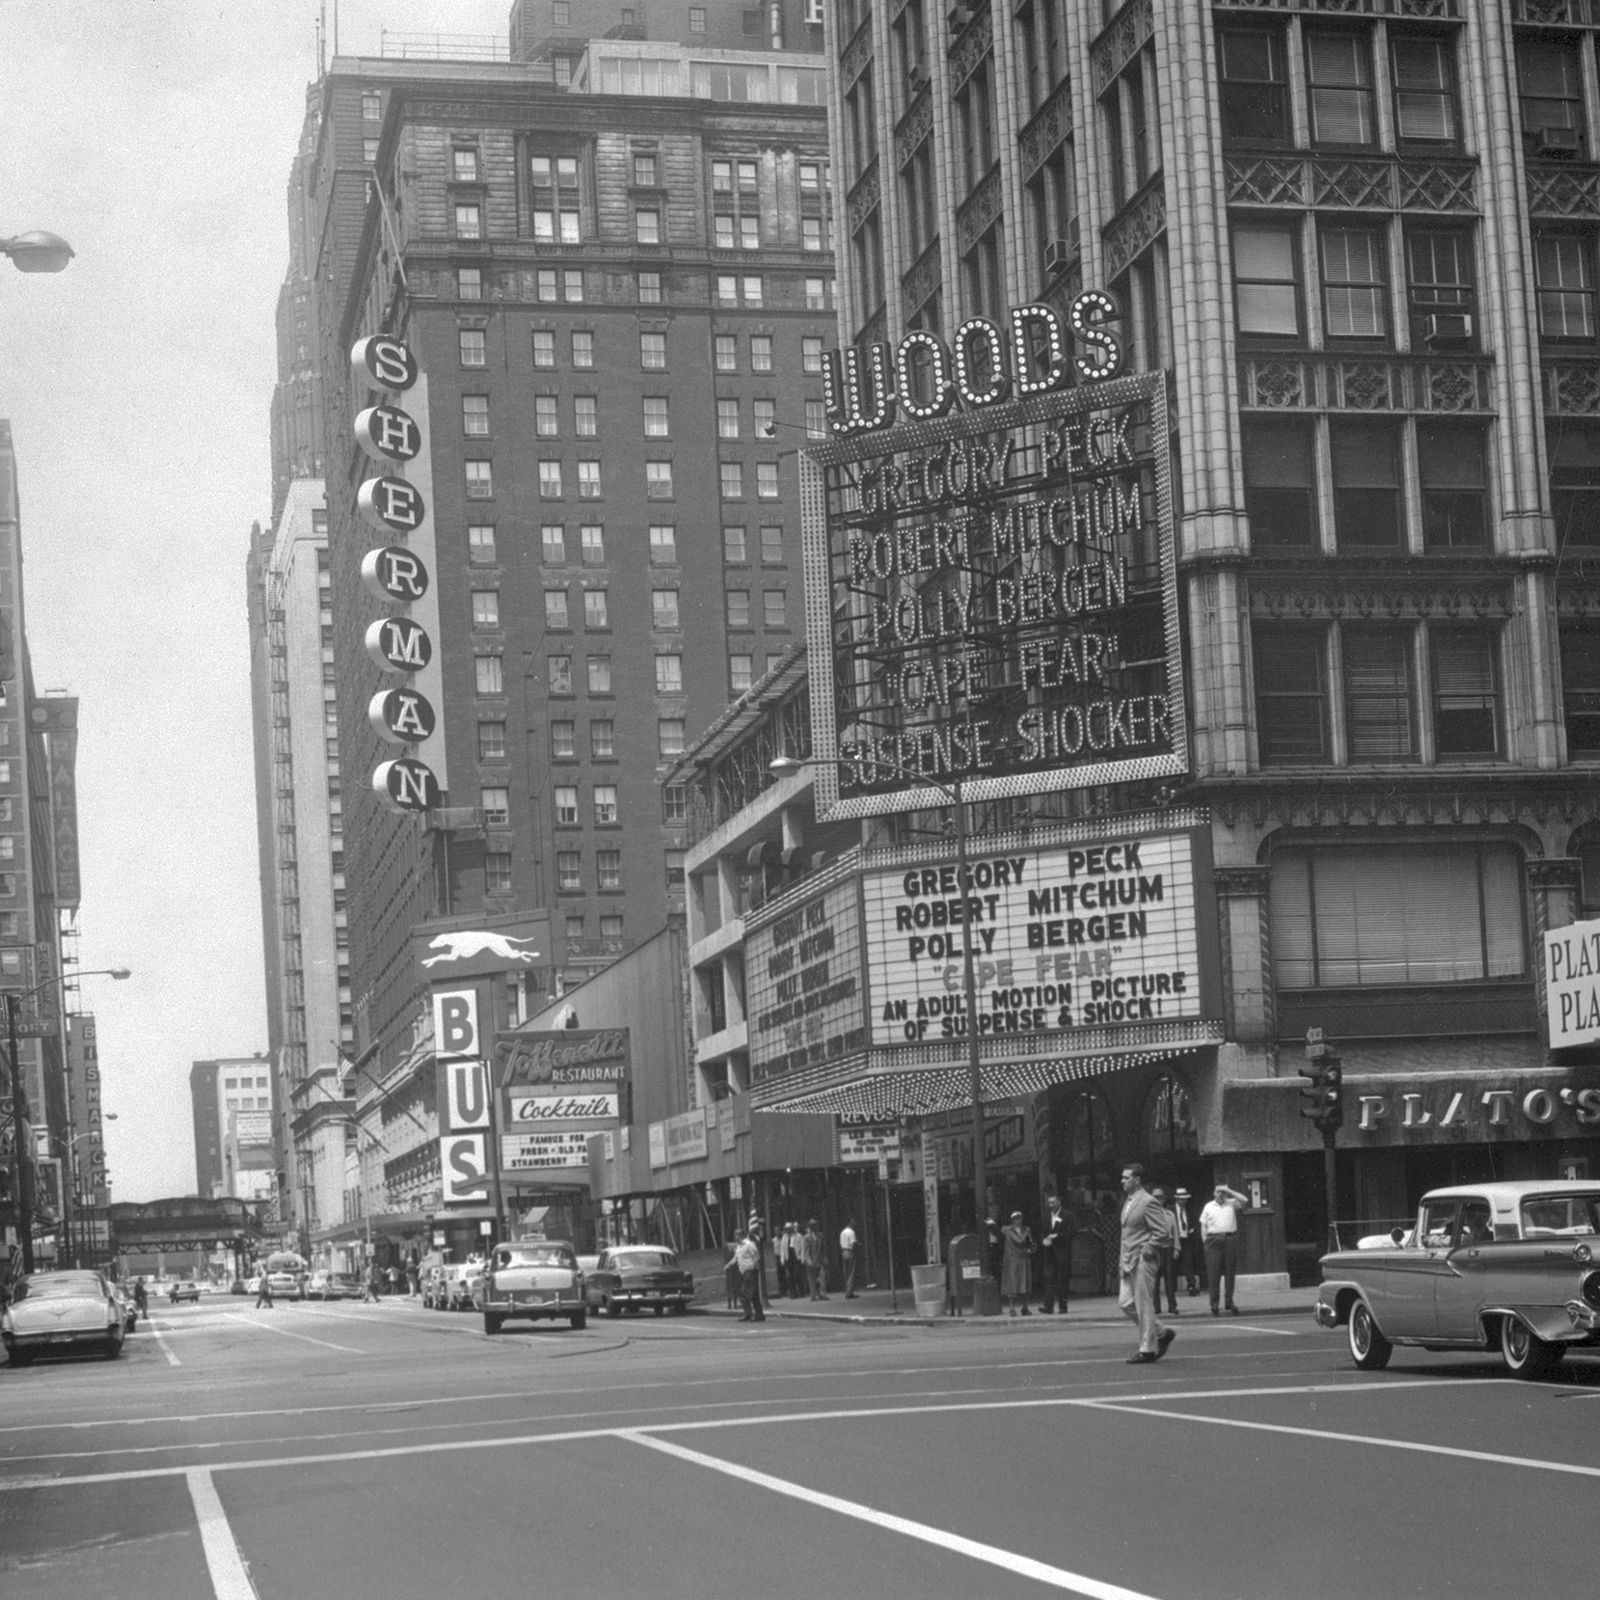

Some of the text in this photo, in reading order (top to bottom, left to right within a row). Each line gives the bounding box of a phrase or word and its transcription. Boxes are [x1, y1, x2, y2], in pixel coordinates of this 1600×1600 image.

[821, 289, 1122, 434] WOODS
[857, 413, 1134, 515] GREGORY PECK
[849, 482, 1142, 586] ROBERT MITCHUM
[375, 341, 431, 804] SHERMAN
[873, 556, 1128, 647] POLLY BERGEN
[886, 633, 1119, 711] "CAPE FEAR"
[839, 720, 993, 787] SUSPENSE
[1017, 695, 1172, 762] SHOCKER
[904, 841, 1143, 899] GREGORY PECK
[896, 873, 1165, 932] ROBERT MITCHUM
[1026, 910, 1148, 950] BERGEN
[882, 998, 909, 1022] AN
[915, 992, 970, 1019] ADUL
[991, 982, 1073, 1012] MOTION
[1090, 970, 1187, 1002] PICTURE
[933, 946, 1123, 992] "CPE FEAR"
[903, 997, 1163, 1042] OF SUPENSE & SHOCK!
[440, 995, 484, 1197] BUS
[551, 1066, 626, 1082] RESTAURANT
[84, 1026, 104, 1186] BISMARCK
[519, 1097, 612, 1120] Cocktails
[1357, 1087, 1600, 1131] PLATO'S
[511, 1157, 567, 1168] STRAWBERRY
[520, 1147, 548, 1156] FRESH
[559, 1145, 574, 1154] OLD
[529, 1134, 585, 1144] FAMOUS FOR
